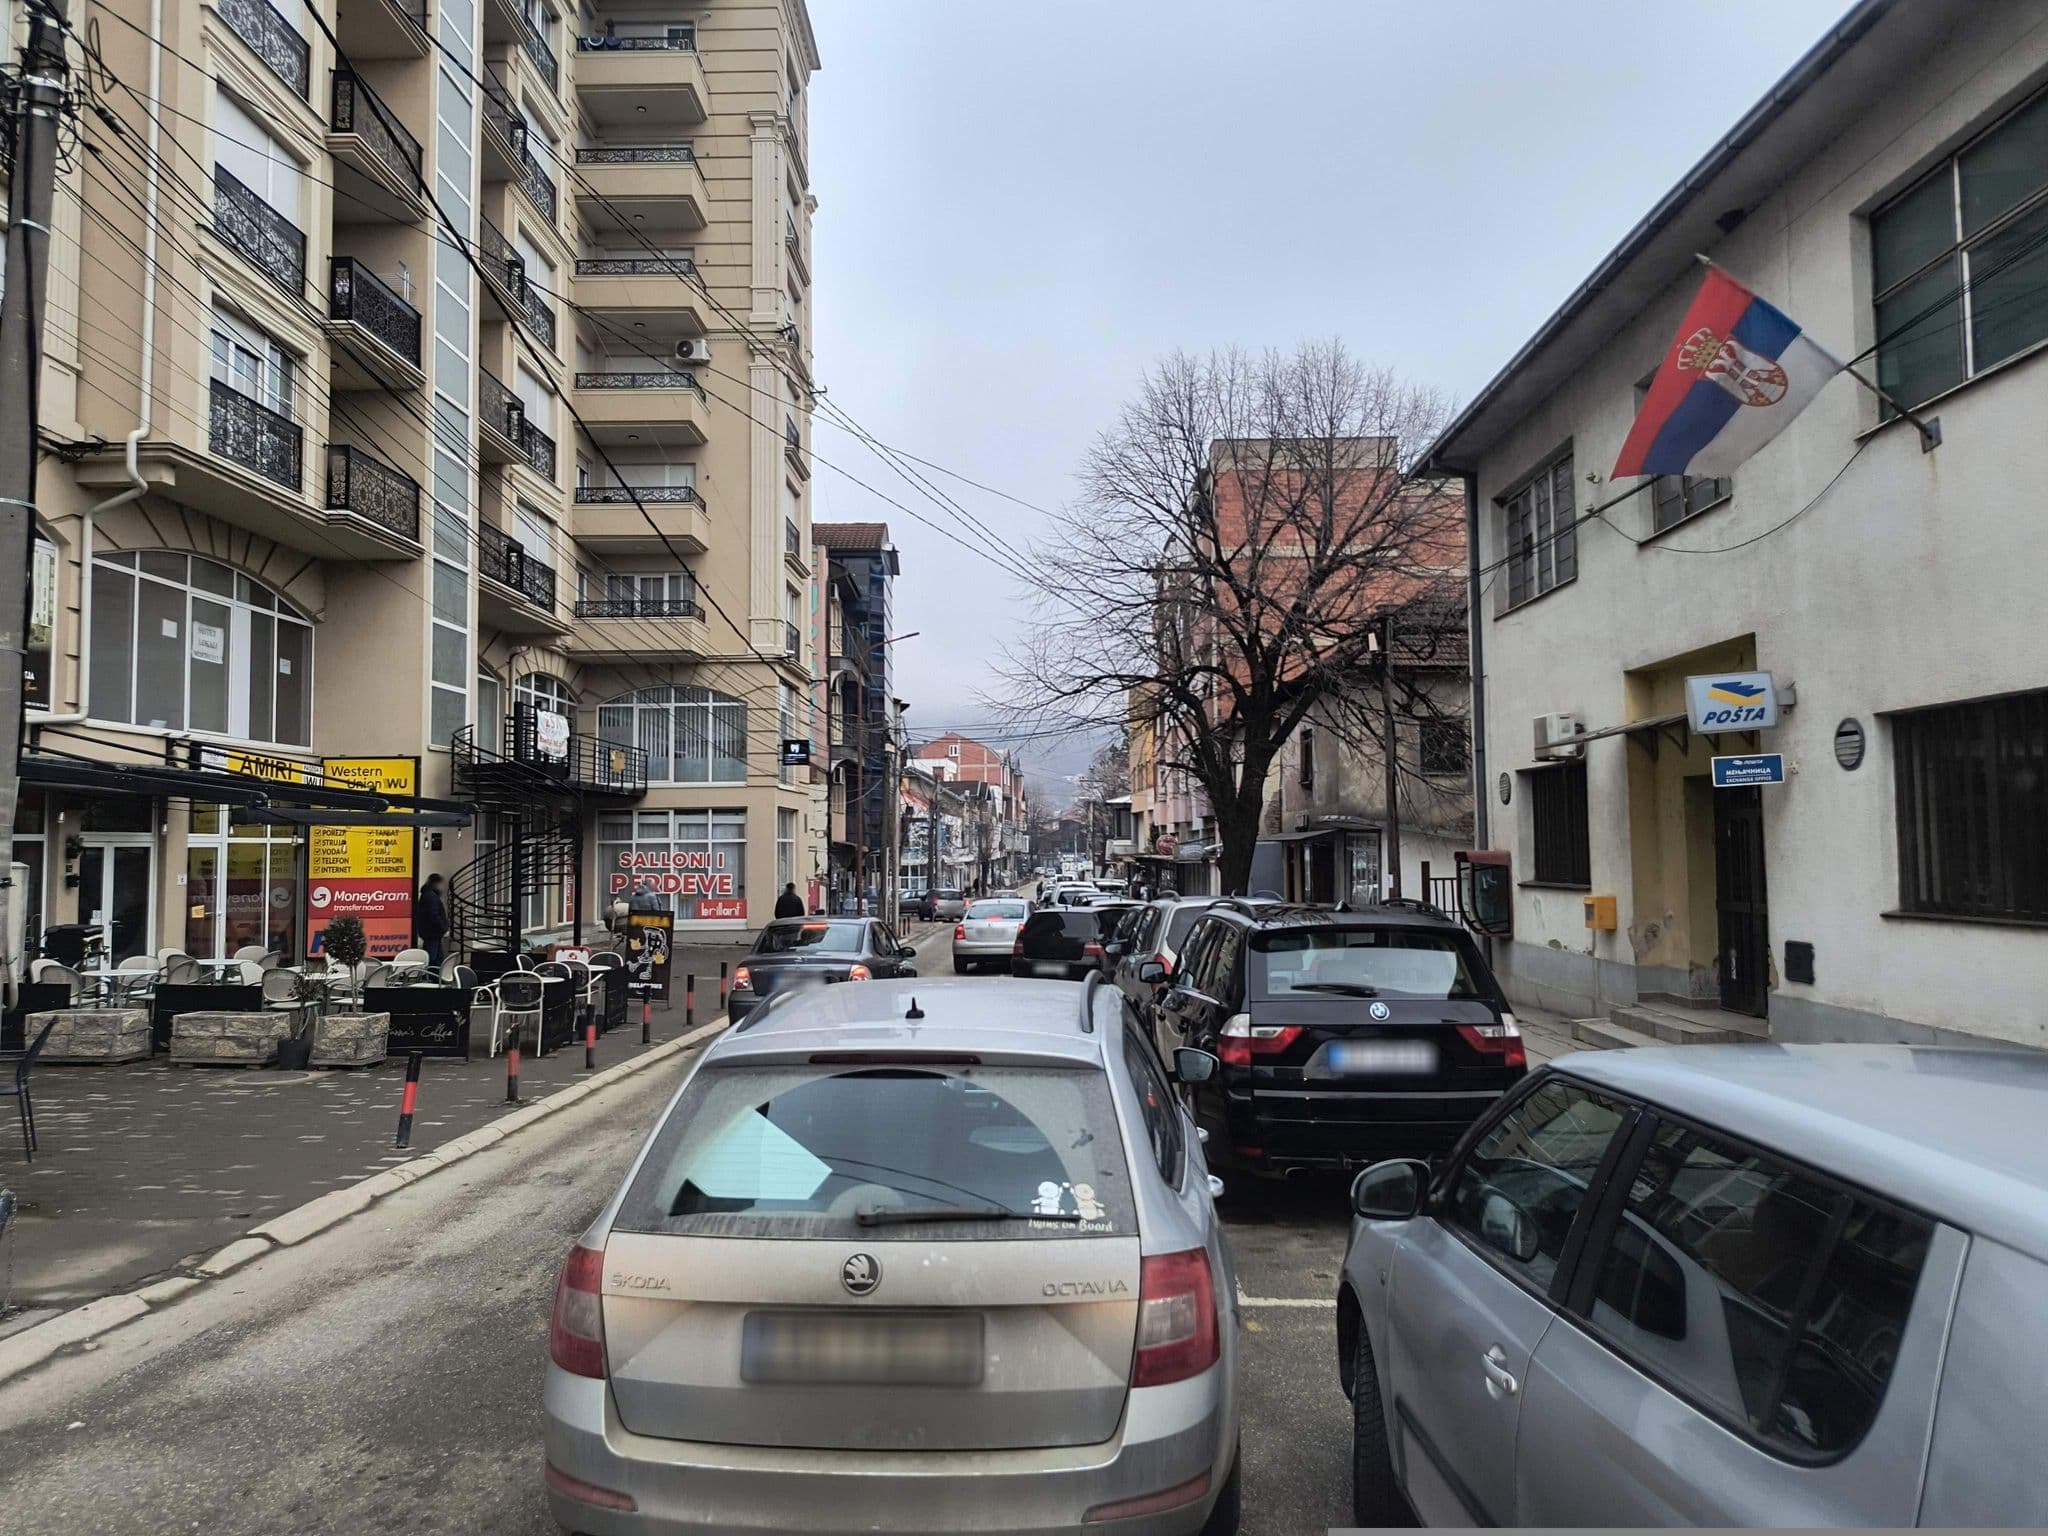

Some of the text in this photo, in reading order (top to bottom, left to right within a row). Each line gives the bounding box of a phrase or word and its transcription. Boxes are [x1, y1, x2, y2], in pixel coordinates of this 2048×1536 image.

[1703, 706, 1766, 725] POŠTA
[240, 755, 292, 781] AMIRI
[330, 765, 383, 777] Western
[347, 778, 408, 790] Union WU
[321, 848, 341, 856] VODA
[321, 857, 350, 865] TELEFON
[374, 857, 404, 865] TELEFONI
[619, 851, 726, 869] SALLONI I
[320, 866, 352, 874] INTERNET
[373, 866, 406, 874] INTERNETI
[610, 873, 734, 895] PERDEVE
[333, 890, 409, 904] MoneyGram
[333, 904, 361, 912] transfer
[701, 902, 741, 917] brillant
[1079, 1219, 1113, 1232] Board
[1041, 1280, 1129, 1298] OCTAVIA
